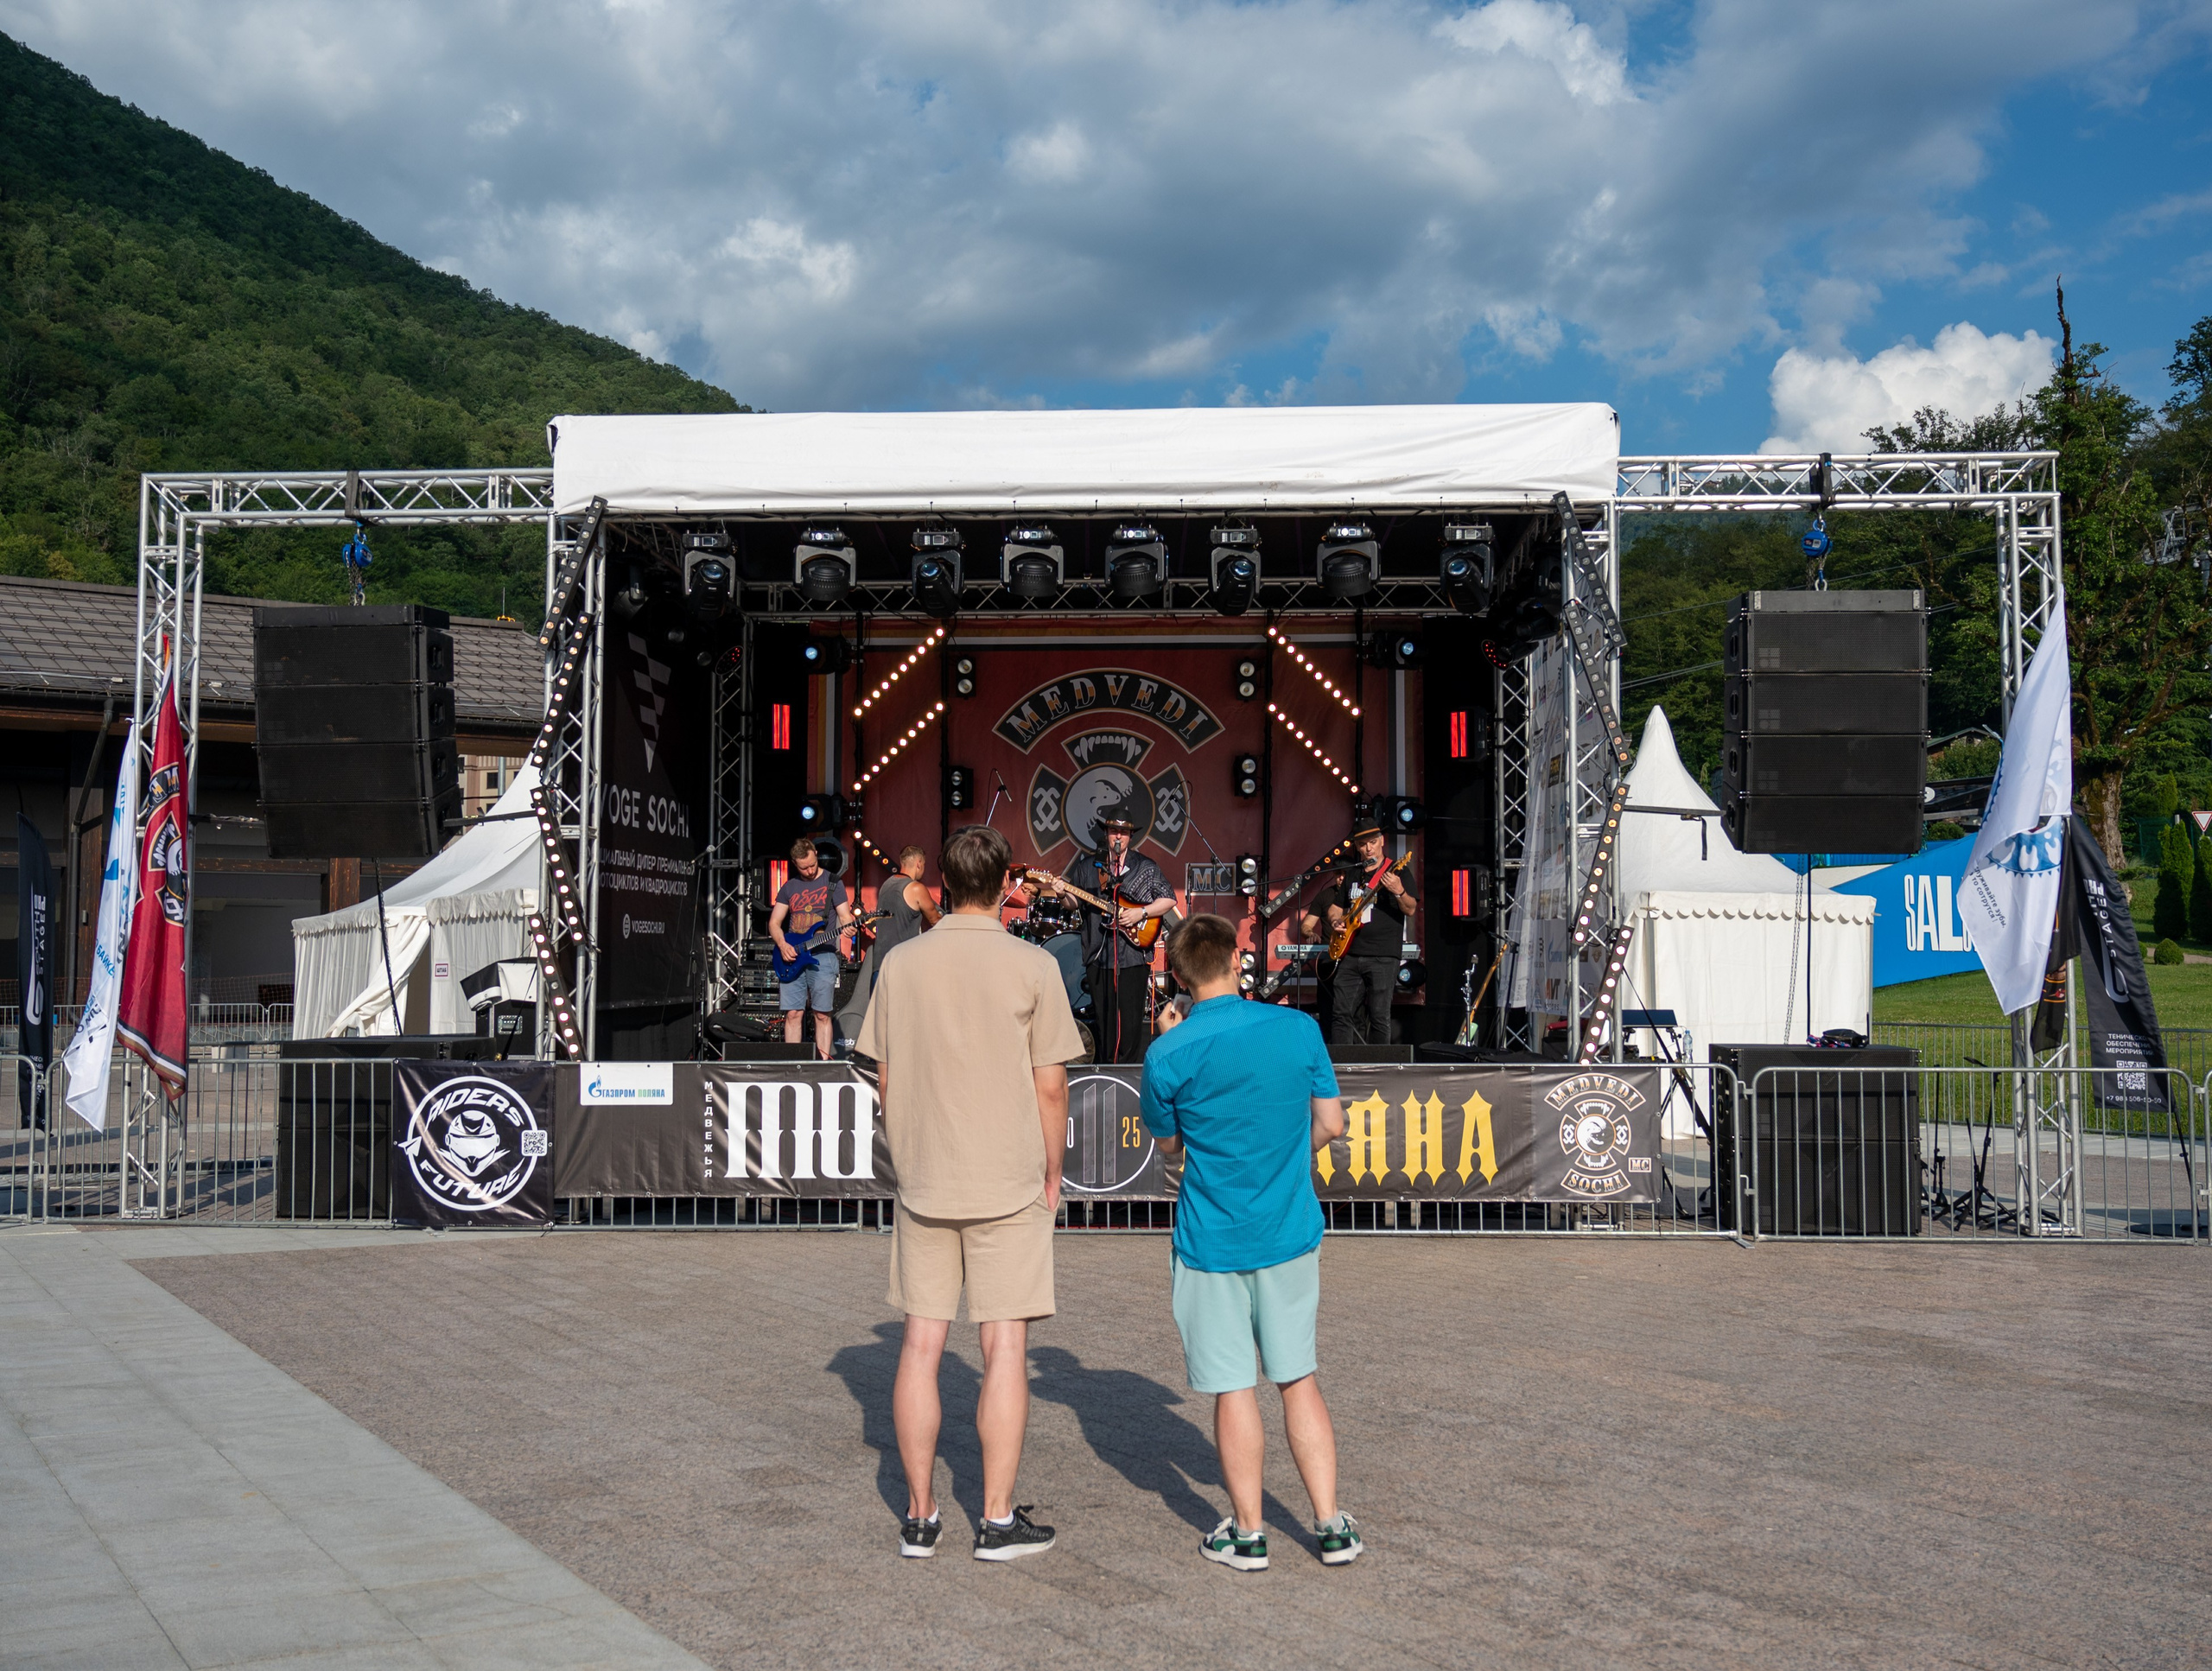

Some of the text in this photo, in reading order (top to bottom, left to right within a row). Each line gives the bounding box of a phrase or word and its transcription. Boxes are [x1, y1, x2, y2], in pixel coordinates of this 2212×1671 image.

[1006, 674, 1208, 743] MEDVEDI
[647, 795, 689, 838] SOCHI
[1192, 867, 1230, 891] MC
[1974, 867, 1998, 907] луживайте
[1904, 874, 1977, 952] SAL
[95, 938, 115, 979] БАЙКЕ
[2107, 1032, 2147, 1041] ТЕНИЧЕСКО
[424, 1087, 524, 1133] RIDERS
[602, 1089, 665, 1098] ГАЗПРОМ ПОЛЯНА
[1550, 1076, 1638, 1106] MEDVEDI
[704, 1081, 713, 1178] МЕДВЕЖЬЯ
[724, 1082, 881, 1179] МО
[1122, 1116, 1141, 1148] 25
[420, 1157, 525, 1199] FUTURE
[1568, 1173, 1624, 1193] SOCHI
[1631, 1160, 1649, 1171] MC
